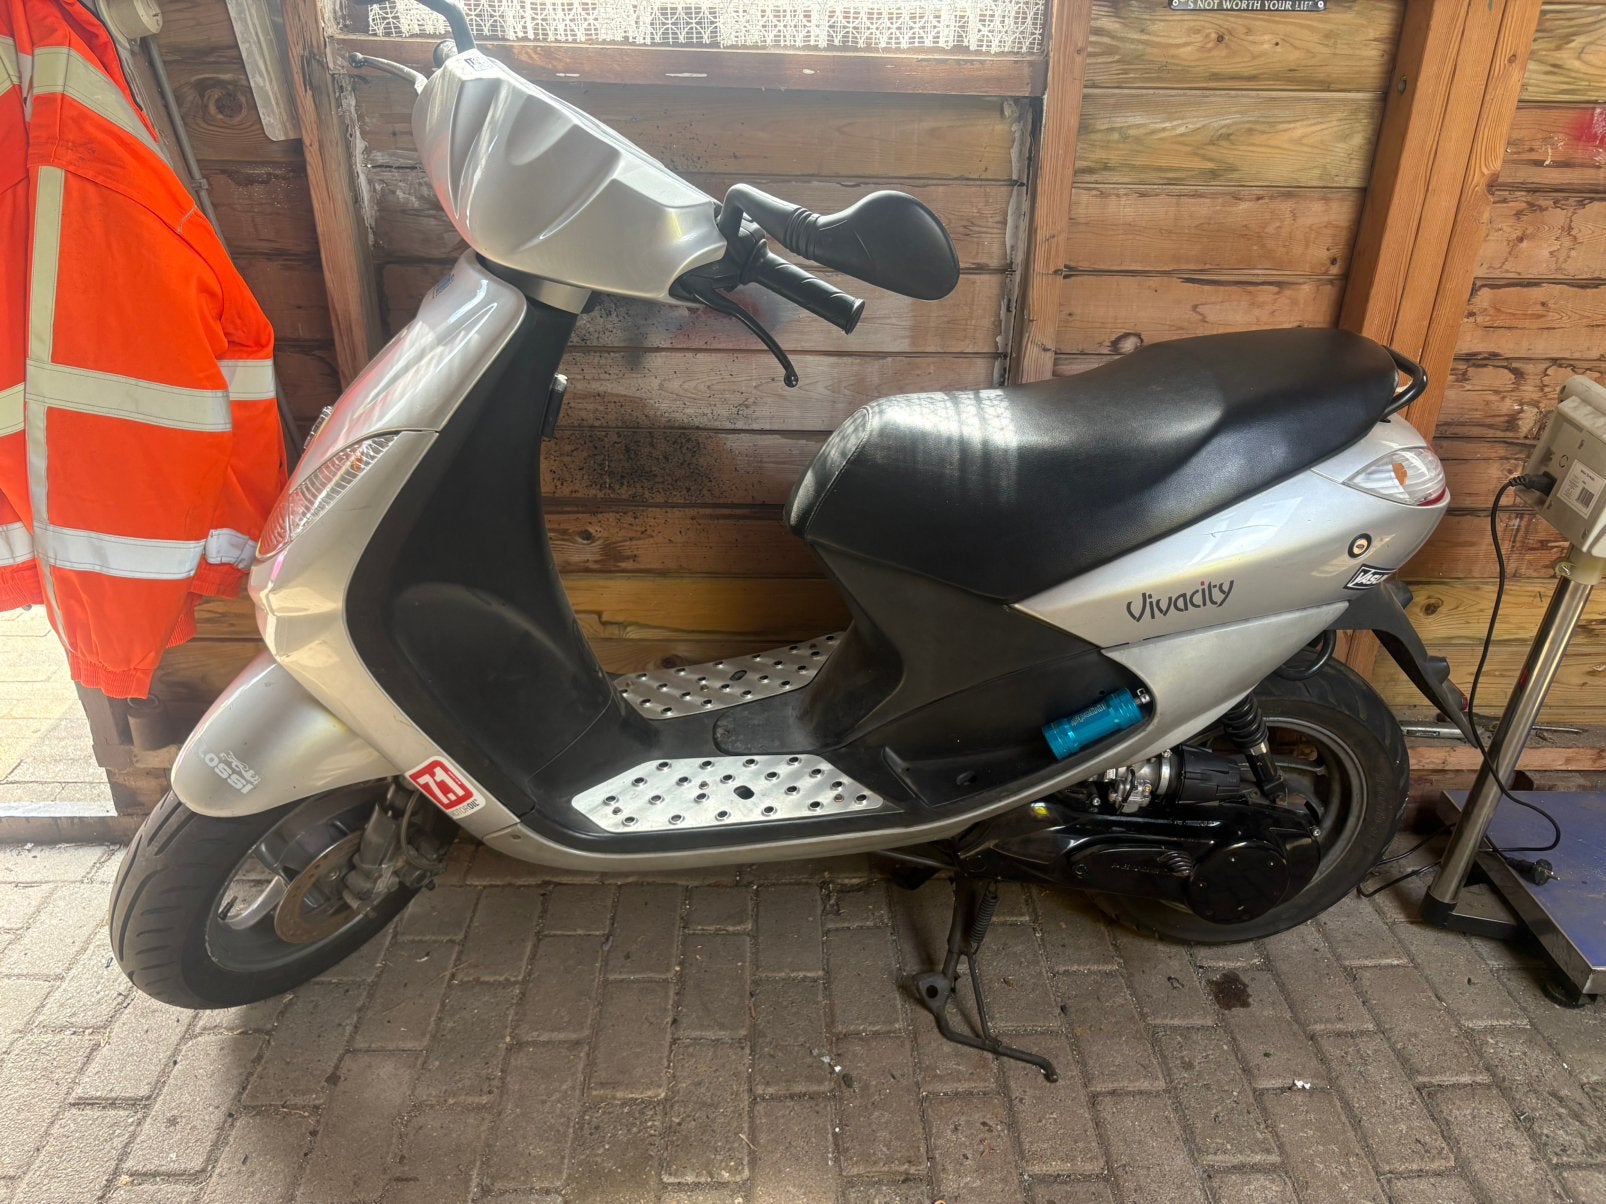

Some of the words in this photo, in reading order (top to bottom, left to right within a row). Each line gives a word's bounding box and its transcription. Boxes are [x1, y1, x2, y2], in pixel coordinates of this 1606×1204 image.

[1197, 0, 1219, 9] NOT
[1222, 0, 1261, 10] WORTH
[1265, 0, 1292, 10] YOUR
[1126, 580, 1234, 622] Vivacity
[415, 766, 466, 805] 7.1
